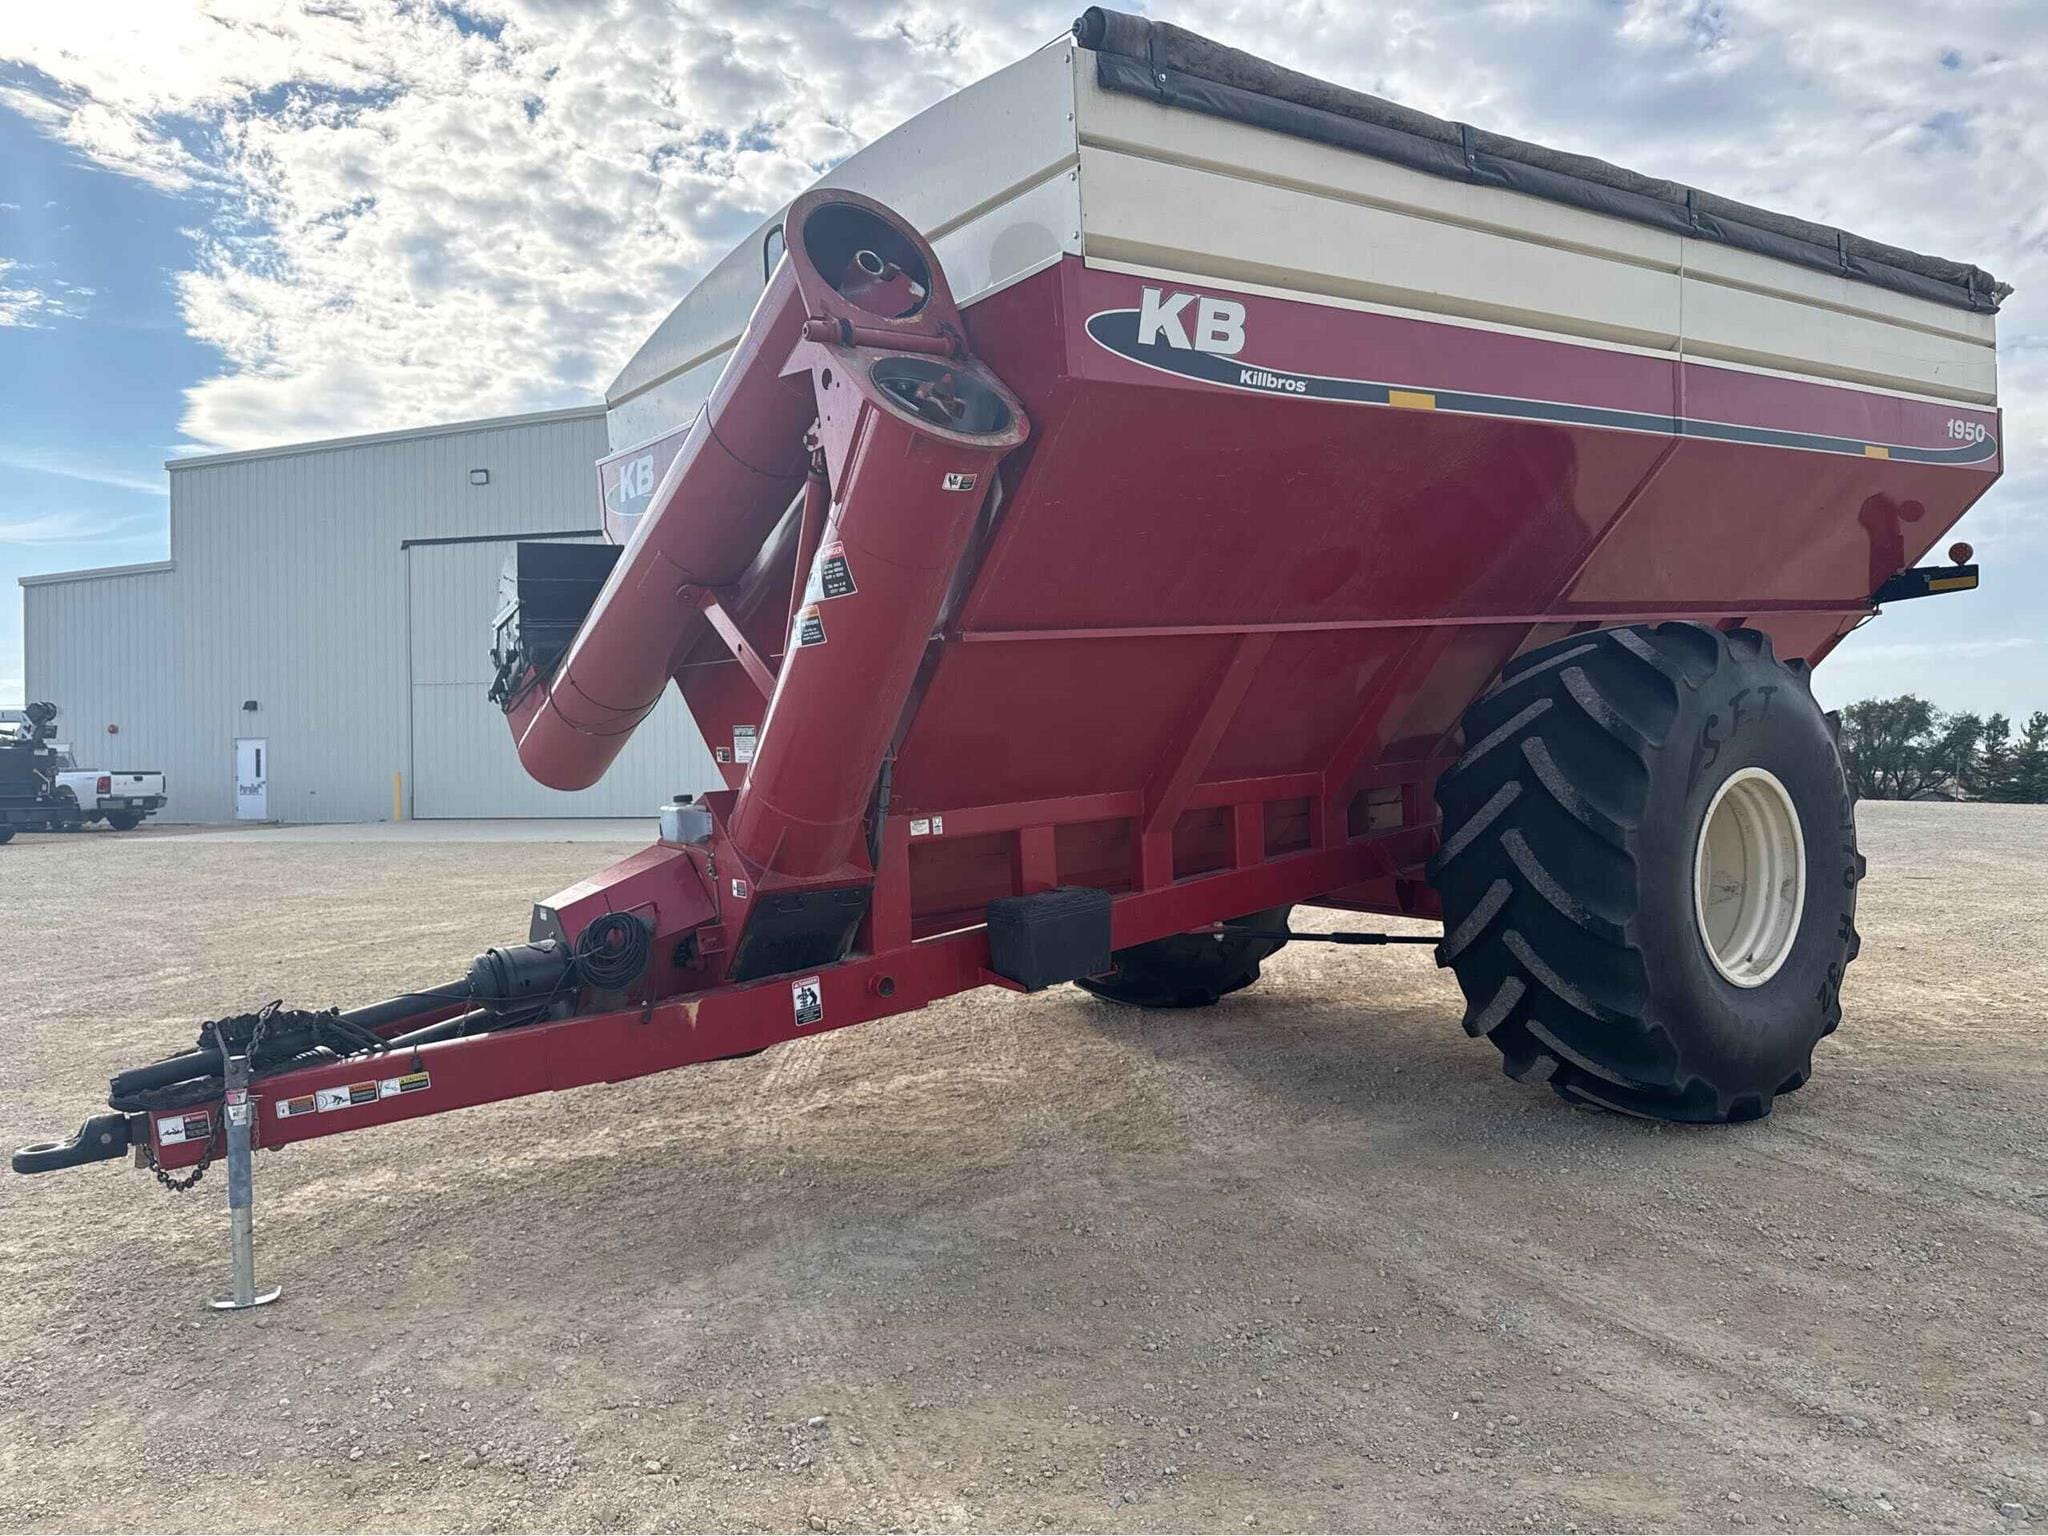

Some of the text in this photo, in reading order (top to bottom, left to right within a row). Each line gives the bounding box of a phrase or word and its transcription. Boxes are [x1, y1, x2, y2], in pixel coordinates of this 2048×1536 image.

[1138, 286, 1246, 355] KB
[1240, 370, 1306, 392] Killbros
[1947, 418, 1986, 442] 1950
[620, 454, 654, 502] KB
